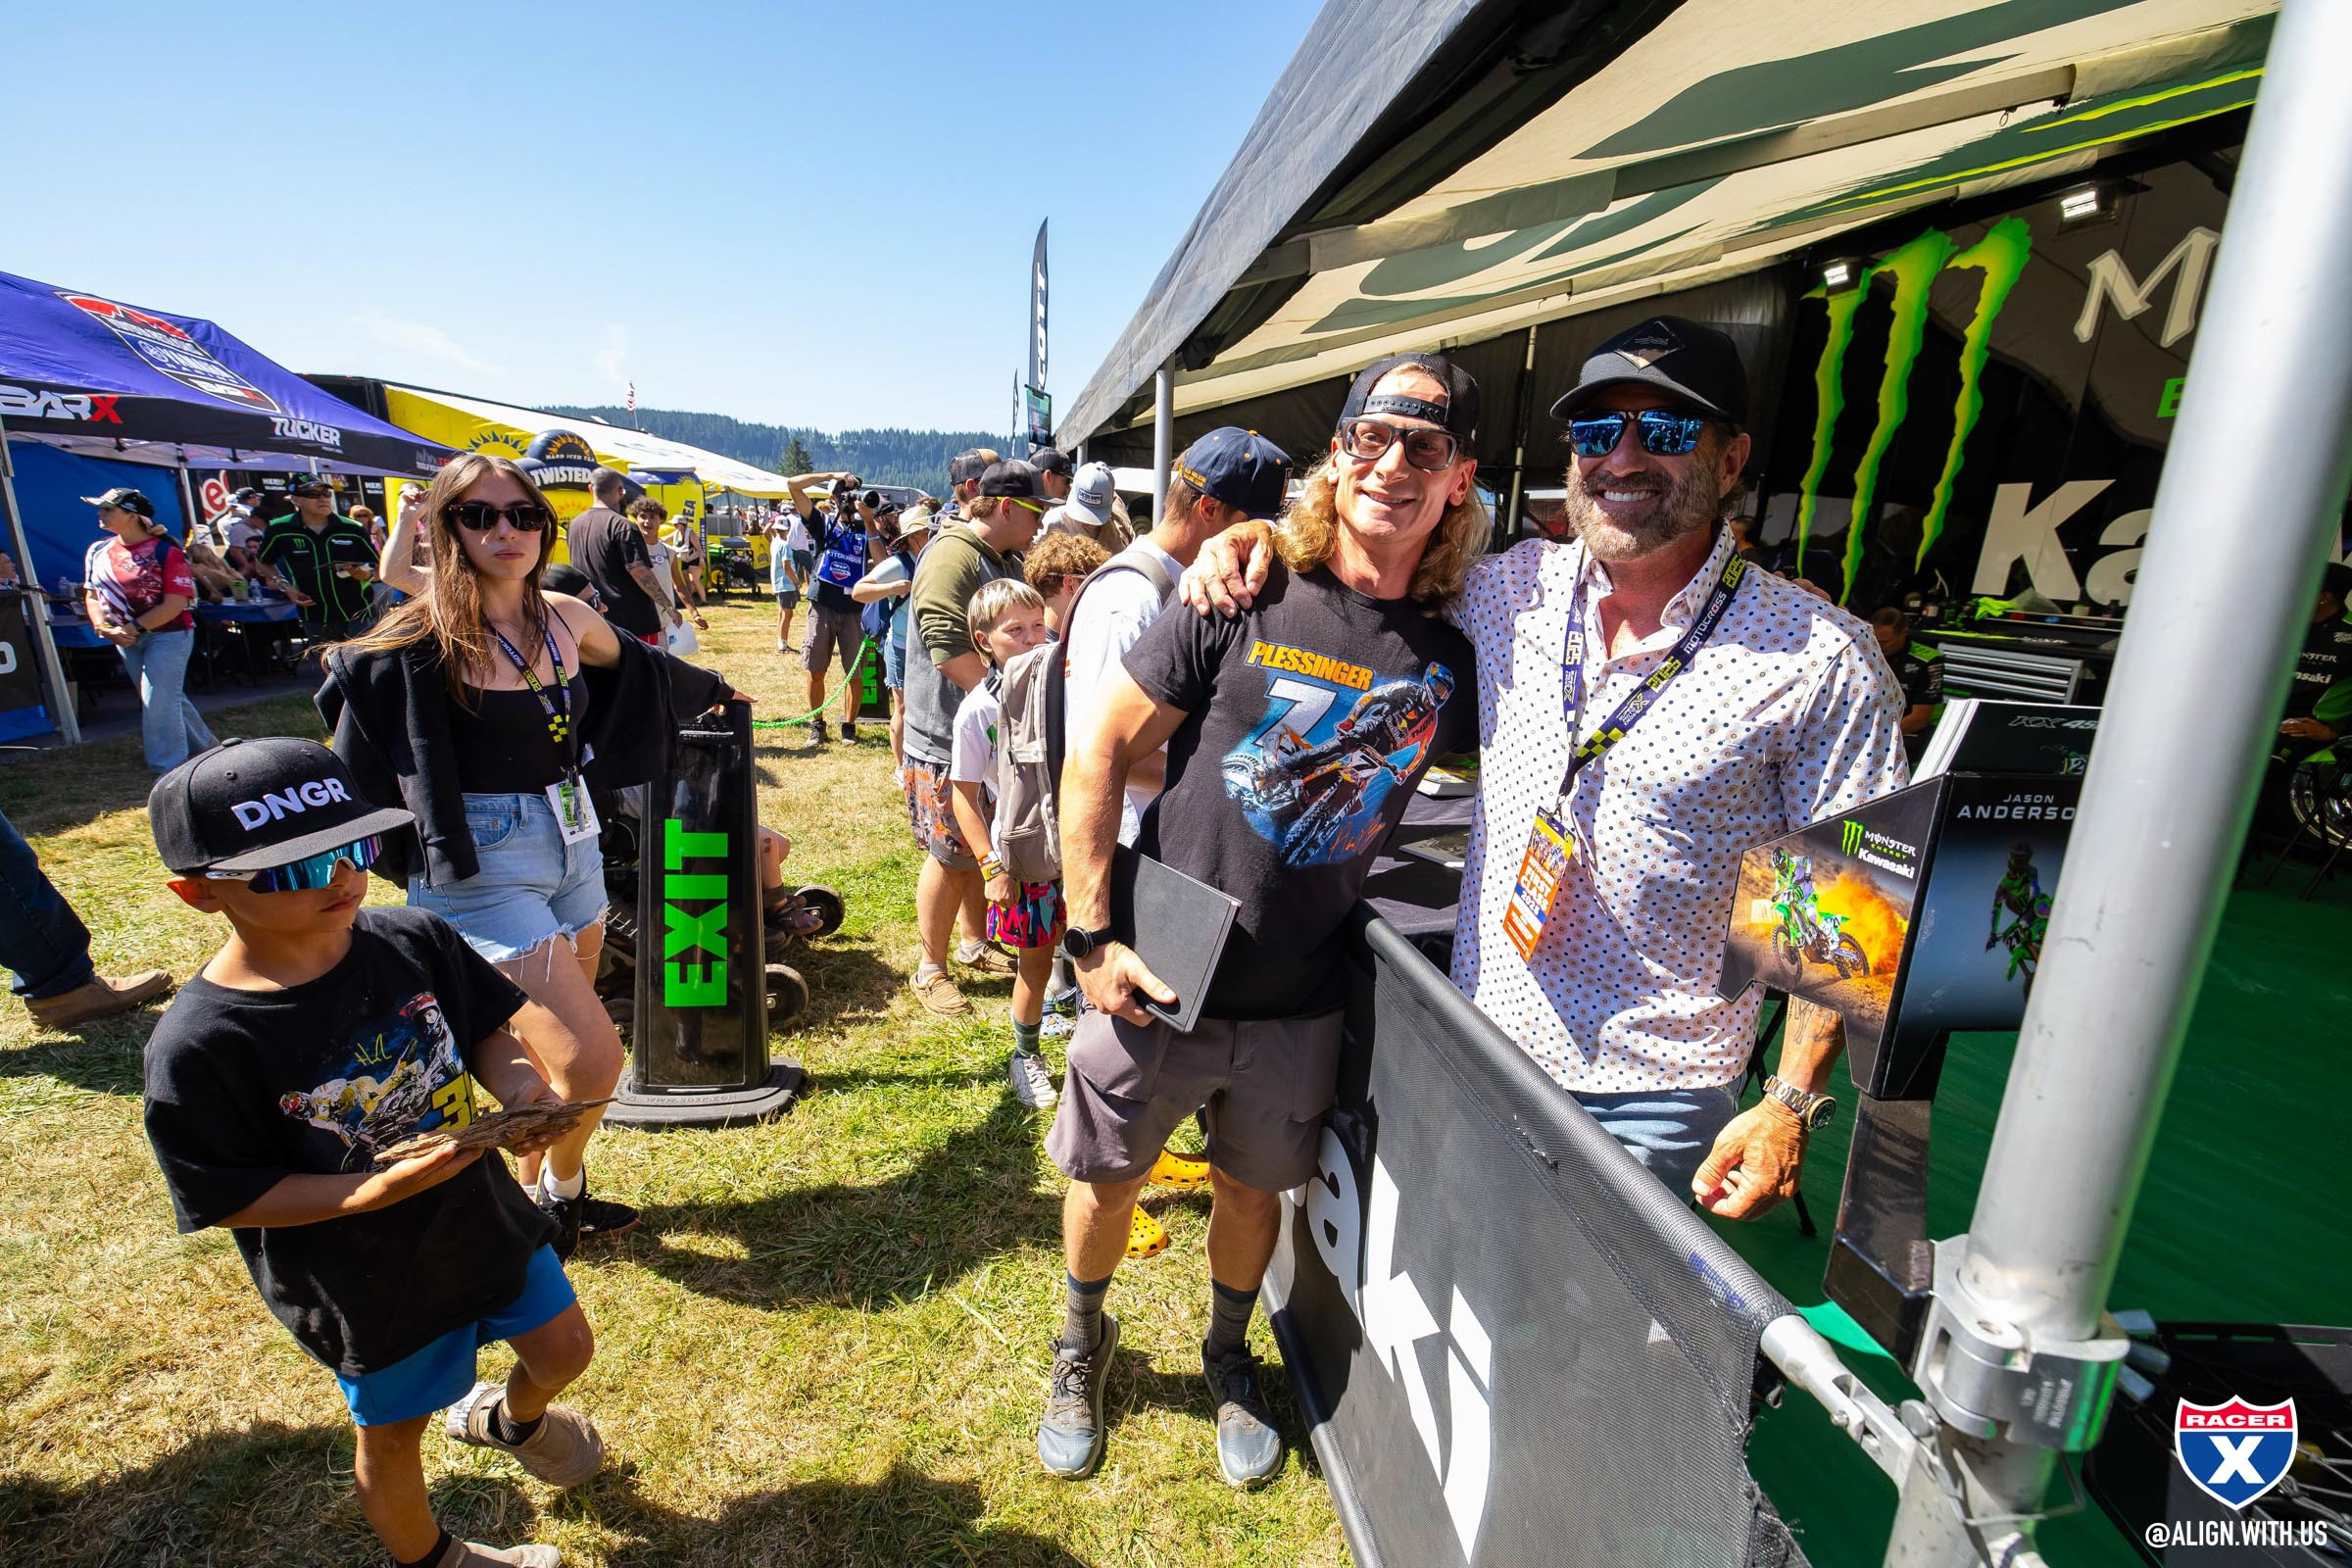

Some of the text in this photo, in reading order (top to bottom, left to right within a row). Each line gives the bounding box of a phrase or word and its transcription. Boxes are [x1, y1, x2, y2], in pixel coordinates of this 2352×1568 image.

[1036, 262, 1048, 391] COTT
[270, 416, 341, 446] TUCKER
[530, 466, 592, 487] TWISTED
[1722, 554, 1747, 589] 2025
[1683, 591, 1727, 655] MOTOCROSS
[1246, 640, 1374, 692] PLESSINGER
[1645, 656, 1683, 693] 2025
[1251, 677, 1338, 757] 7
[2062, 719, 2100, 730] 45
[230, 777, 353, 832] DNGR
[1956, 804, 2077, 821] ANDERSO
[2003, 794, 2055, 804] JASON
[1864, 830, 1917, 858] MONSTER
[1871, 843, 1908, 859] ENERGY
[1523, 863, 1553, 896] FIRST
[1857, 847, 1916, 879] Kawasaki
[1520, 873, 1549, 911] CLASS
[664, 818, 729, 1007] EXIT
